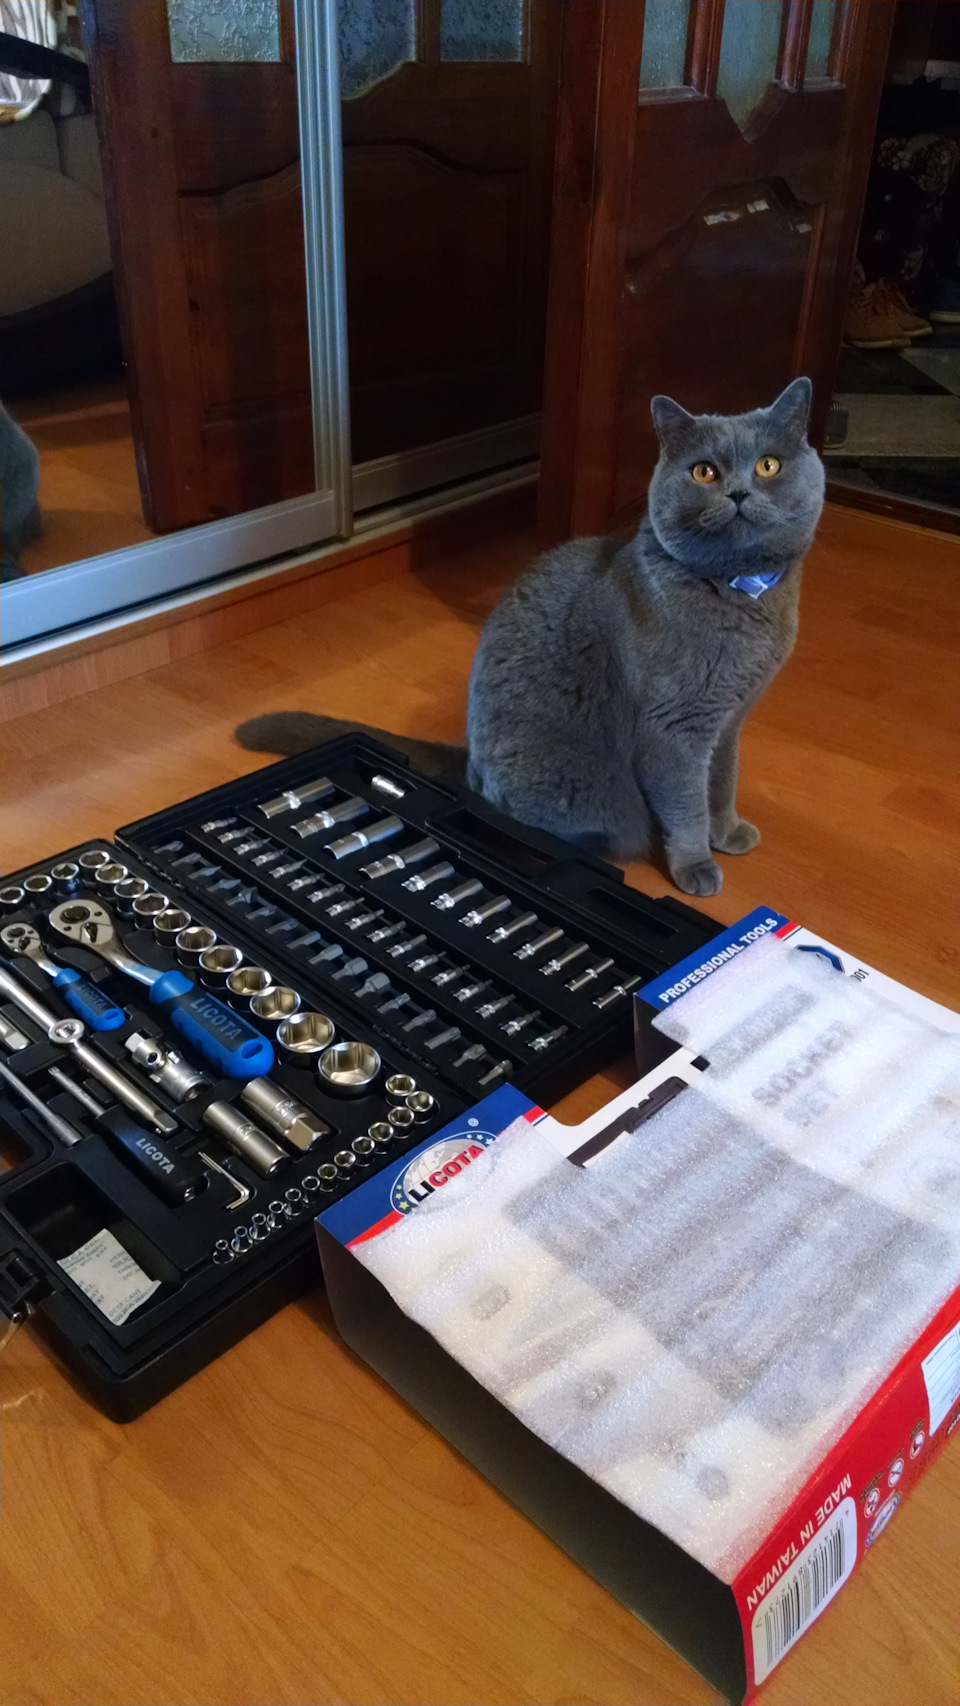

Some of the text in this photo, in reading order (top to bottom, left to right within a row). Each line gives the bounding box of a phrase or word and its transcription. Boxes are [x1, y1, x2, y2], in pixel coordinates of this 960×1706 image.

[659, 917, 778, 1003] PROFESSIONAL TOOLS
[76, 984, 108, 1009] LICOTA
[190, 997, 243, 1041] LICOTA
[136, 1137, 175, 1175] LICOTA
[408, 1144, 485, 1203] LICOTA
[108, 1287, 141, 1318] DESICCANT
[747, 1473, 852, 1611] MADE IN TAIWAN
